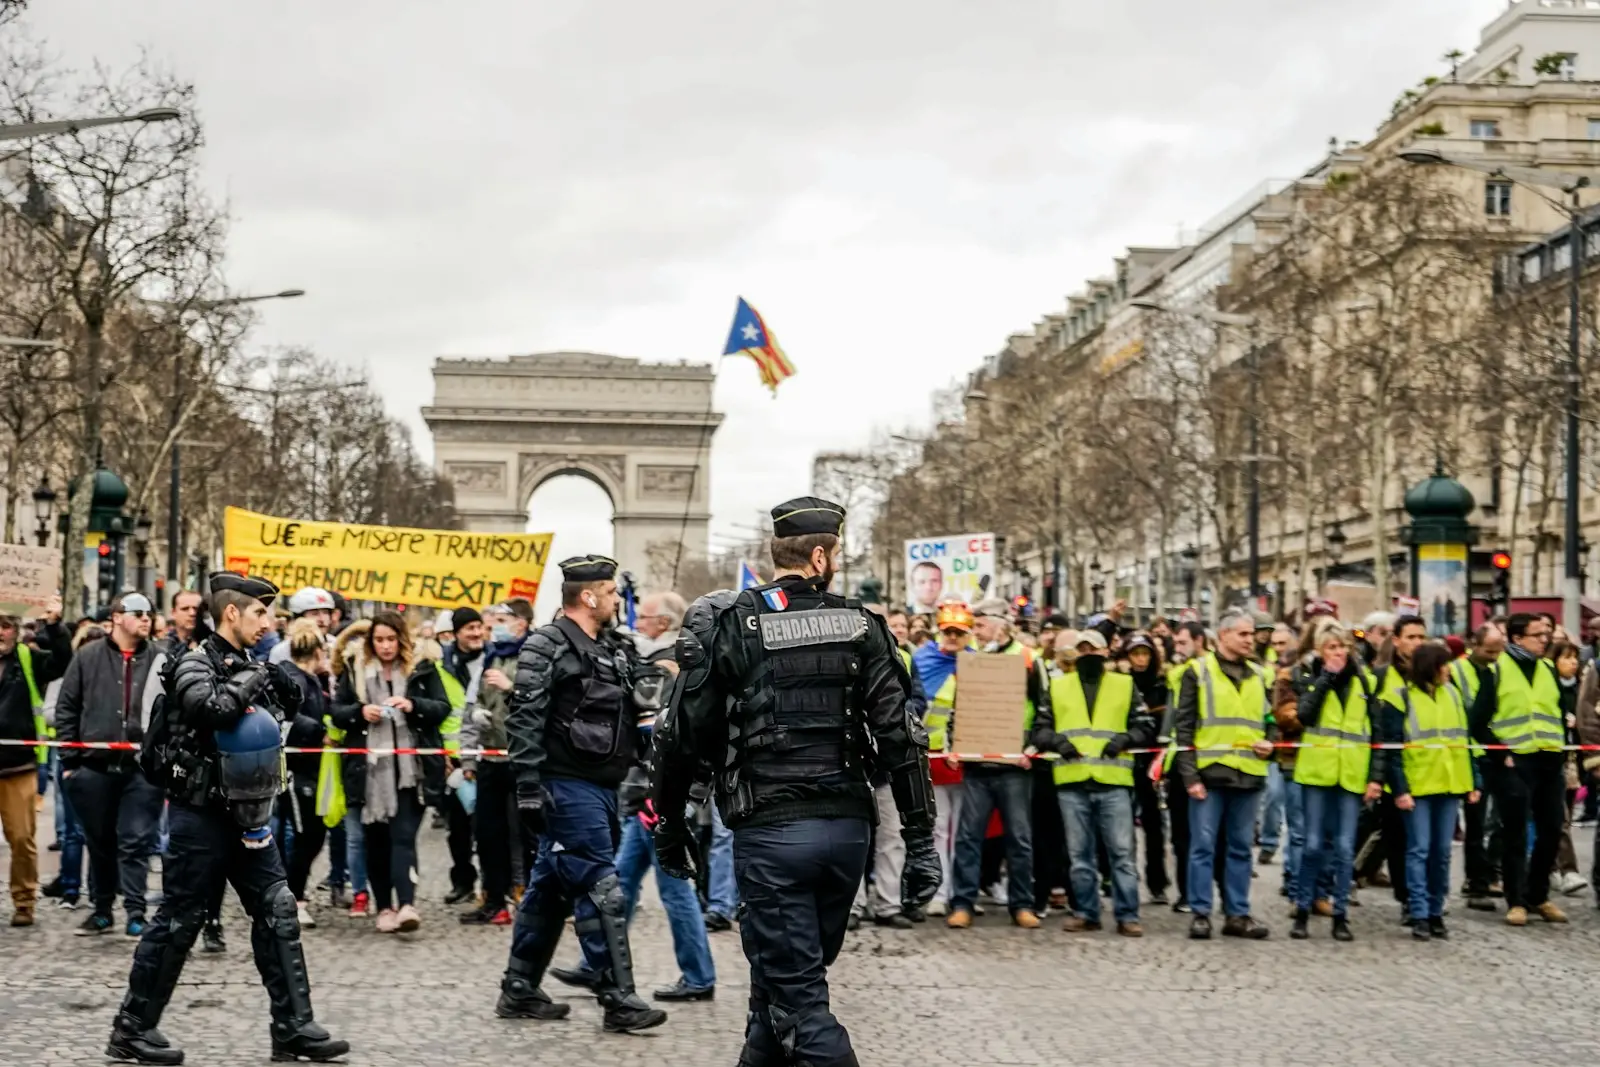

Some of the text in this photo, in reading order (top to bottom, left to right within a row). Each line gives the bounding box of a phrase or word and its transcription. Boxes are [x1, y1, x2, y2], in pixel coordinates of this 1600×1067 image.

[967, 538, 991, 554] CE
[952, 556, 979, 573] DU
[762, 614, 862, 642] GENDARMERIE
